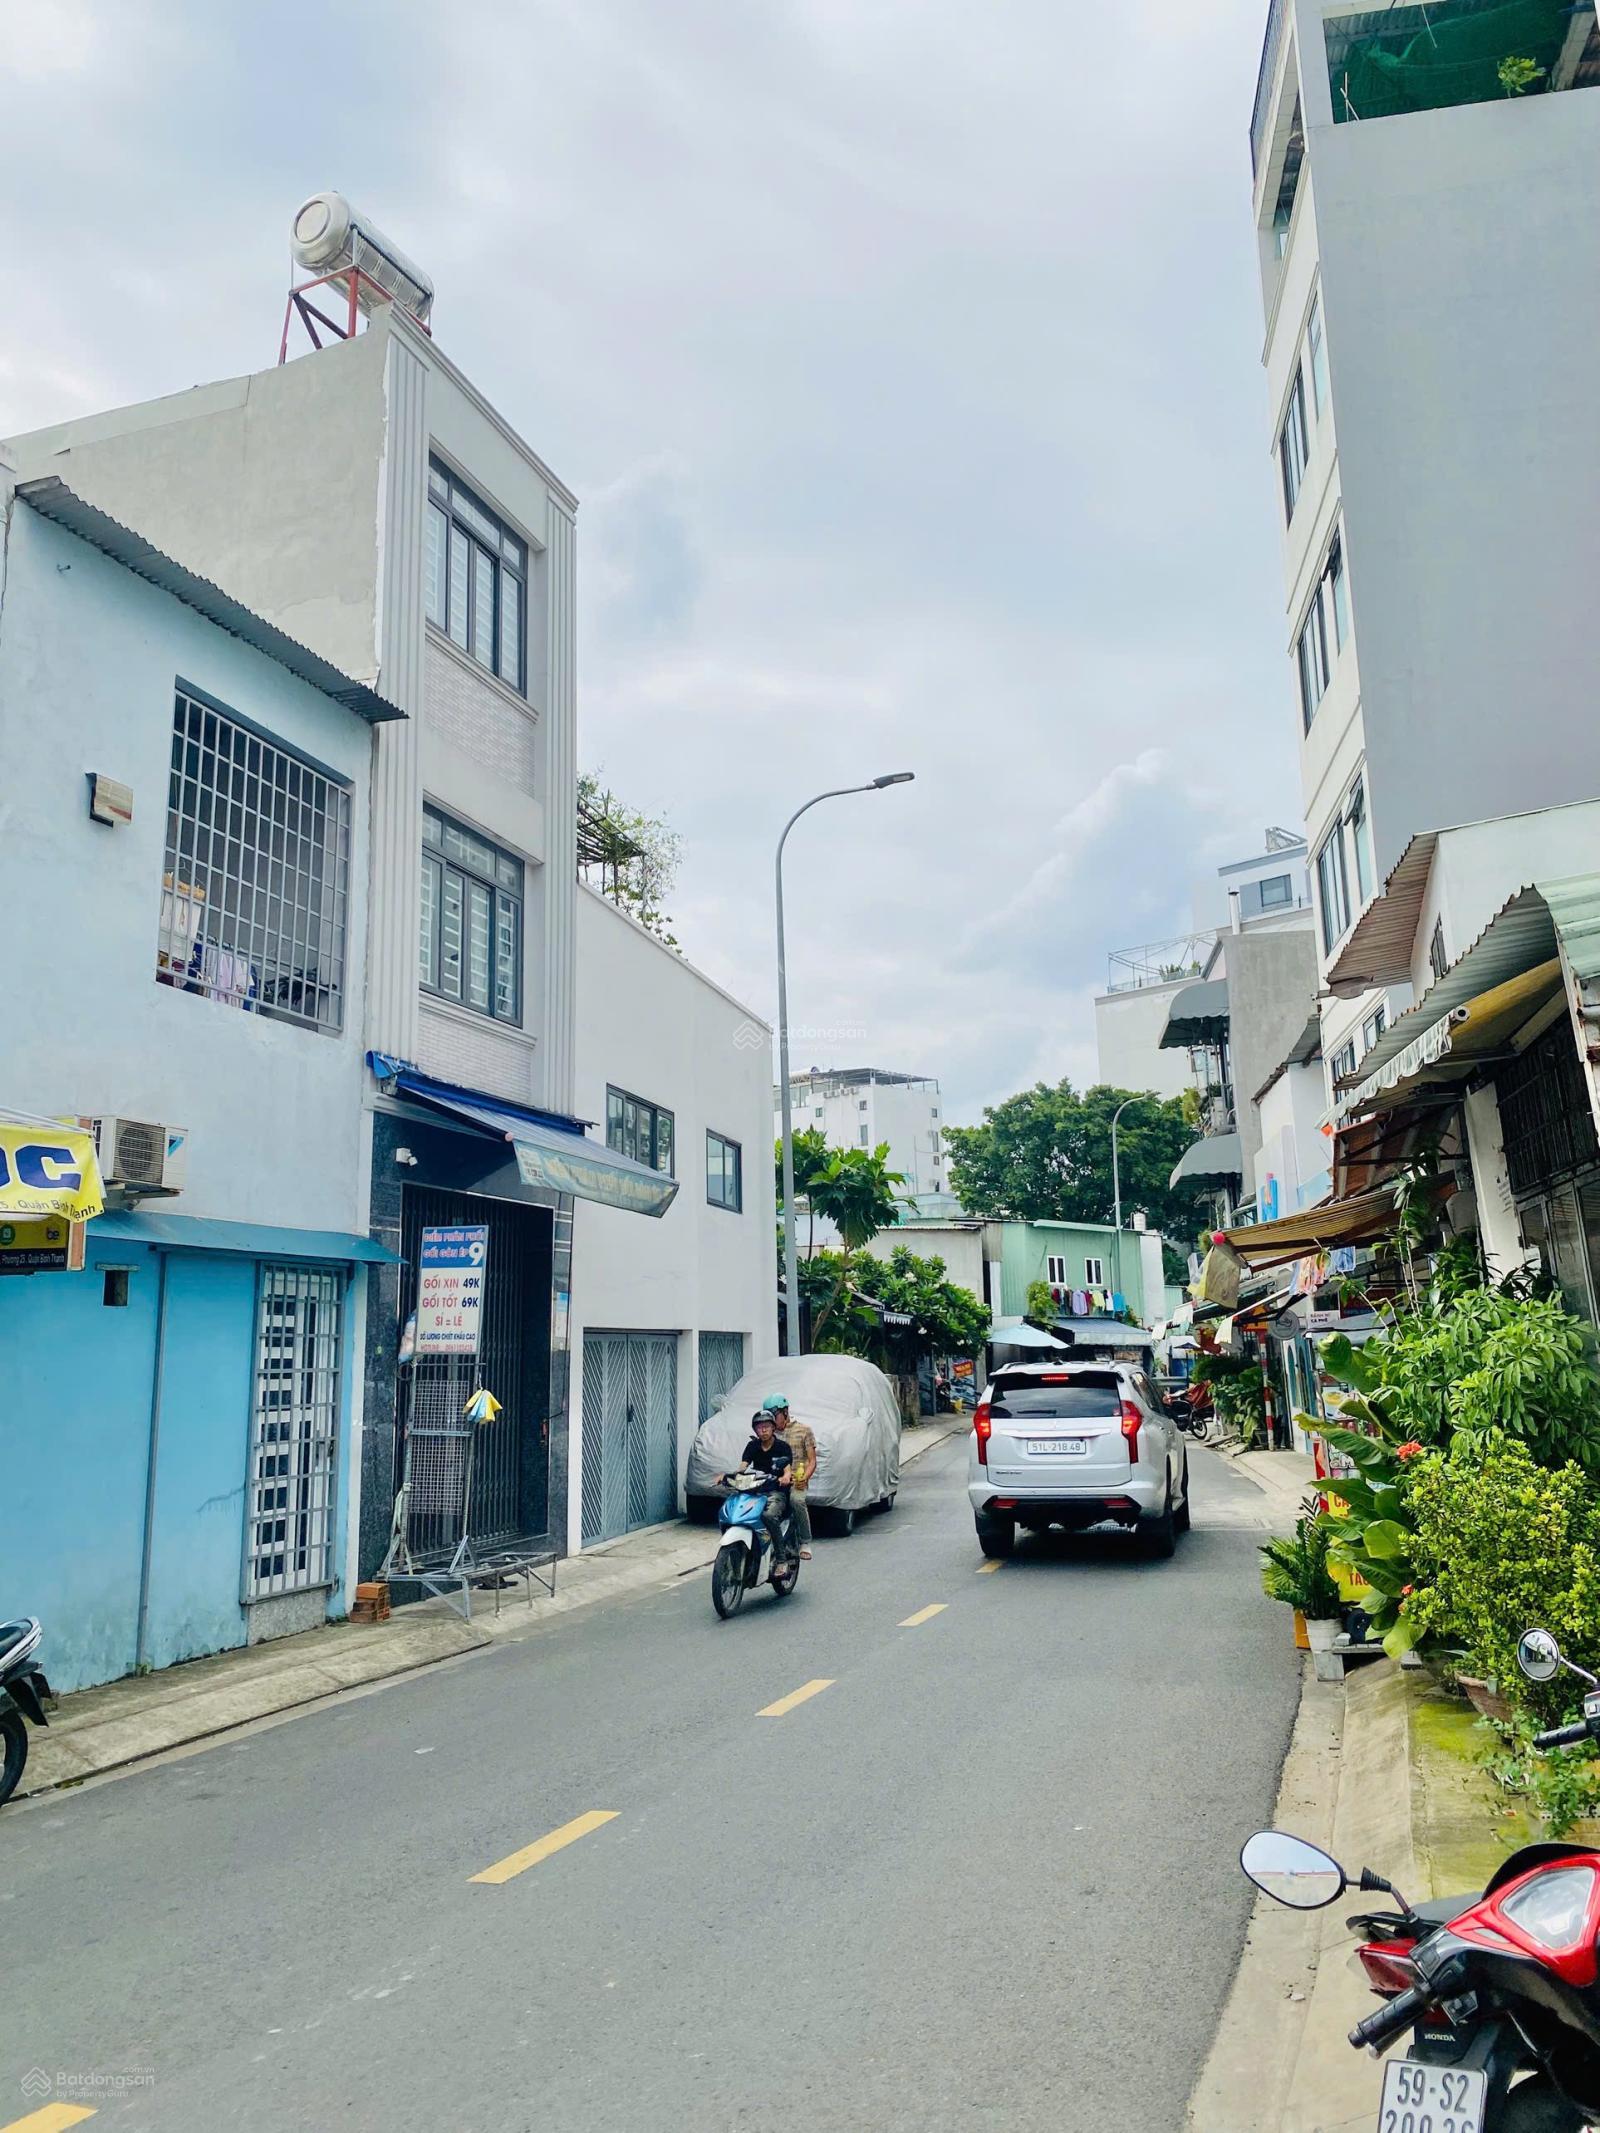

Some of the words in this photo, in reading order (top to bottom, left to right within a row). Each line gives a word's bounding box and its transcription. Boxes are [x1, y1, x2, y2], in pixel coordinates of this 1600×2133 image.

[423, 1274, 441, 1289] GỐI
[463, 1277, 480, 1289] 49K
[422, 1293, 440, 1308] GỐI
[442, 1293, 459, 1308] TỐT
[461, 1296, 479, 1308] 69K
[1424, 2033, 1456, 2042] HONDA
[1397, 2067, 1469, 2113] 59-S2
